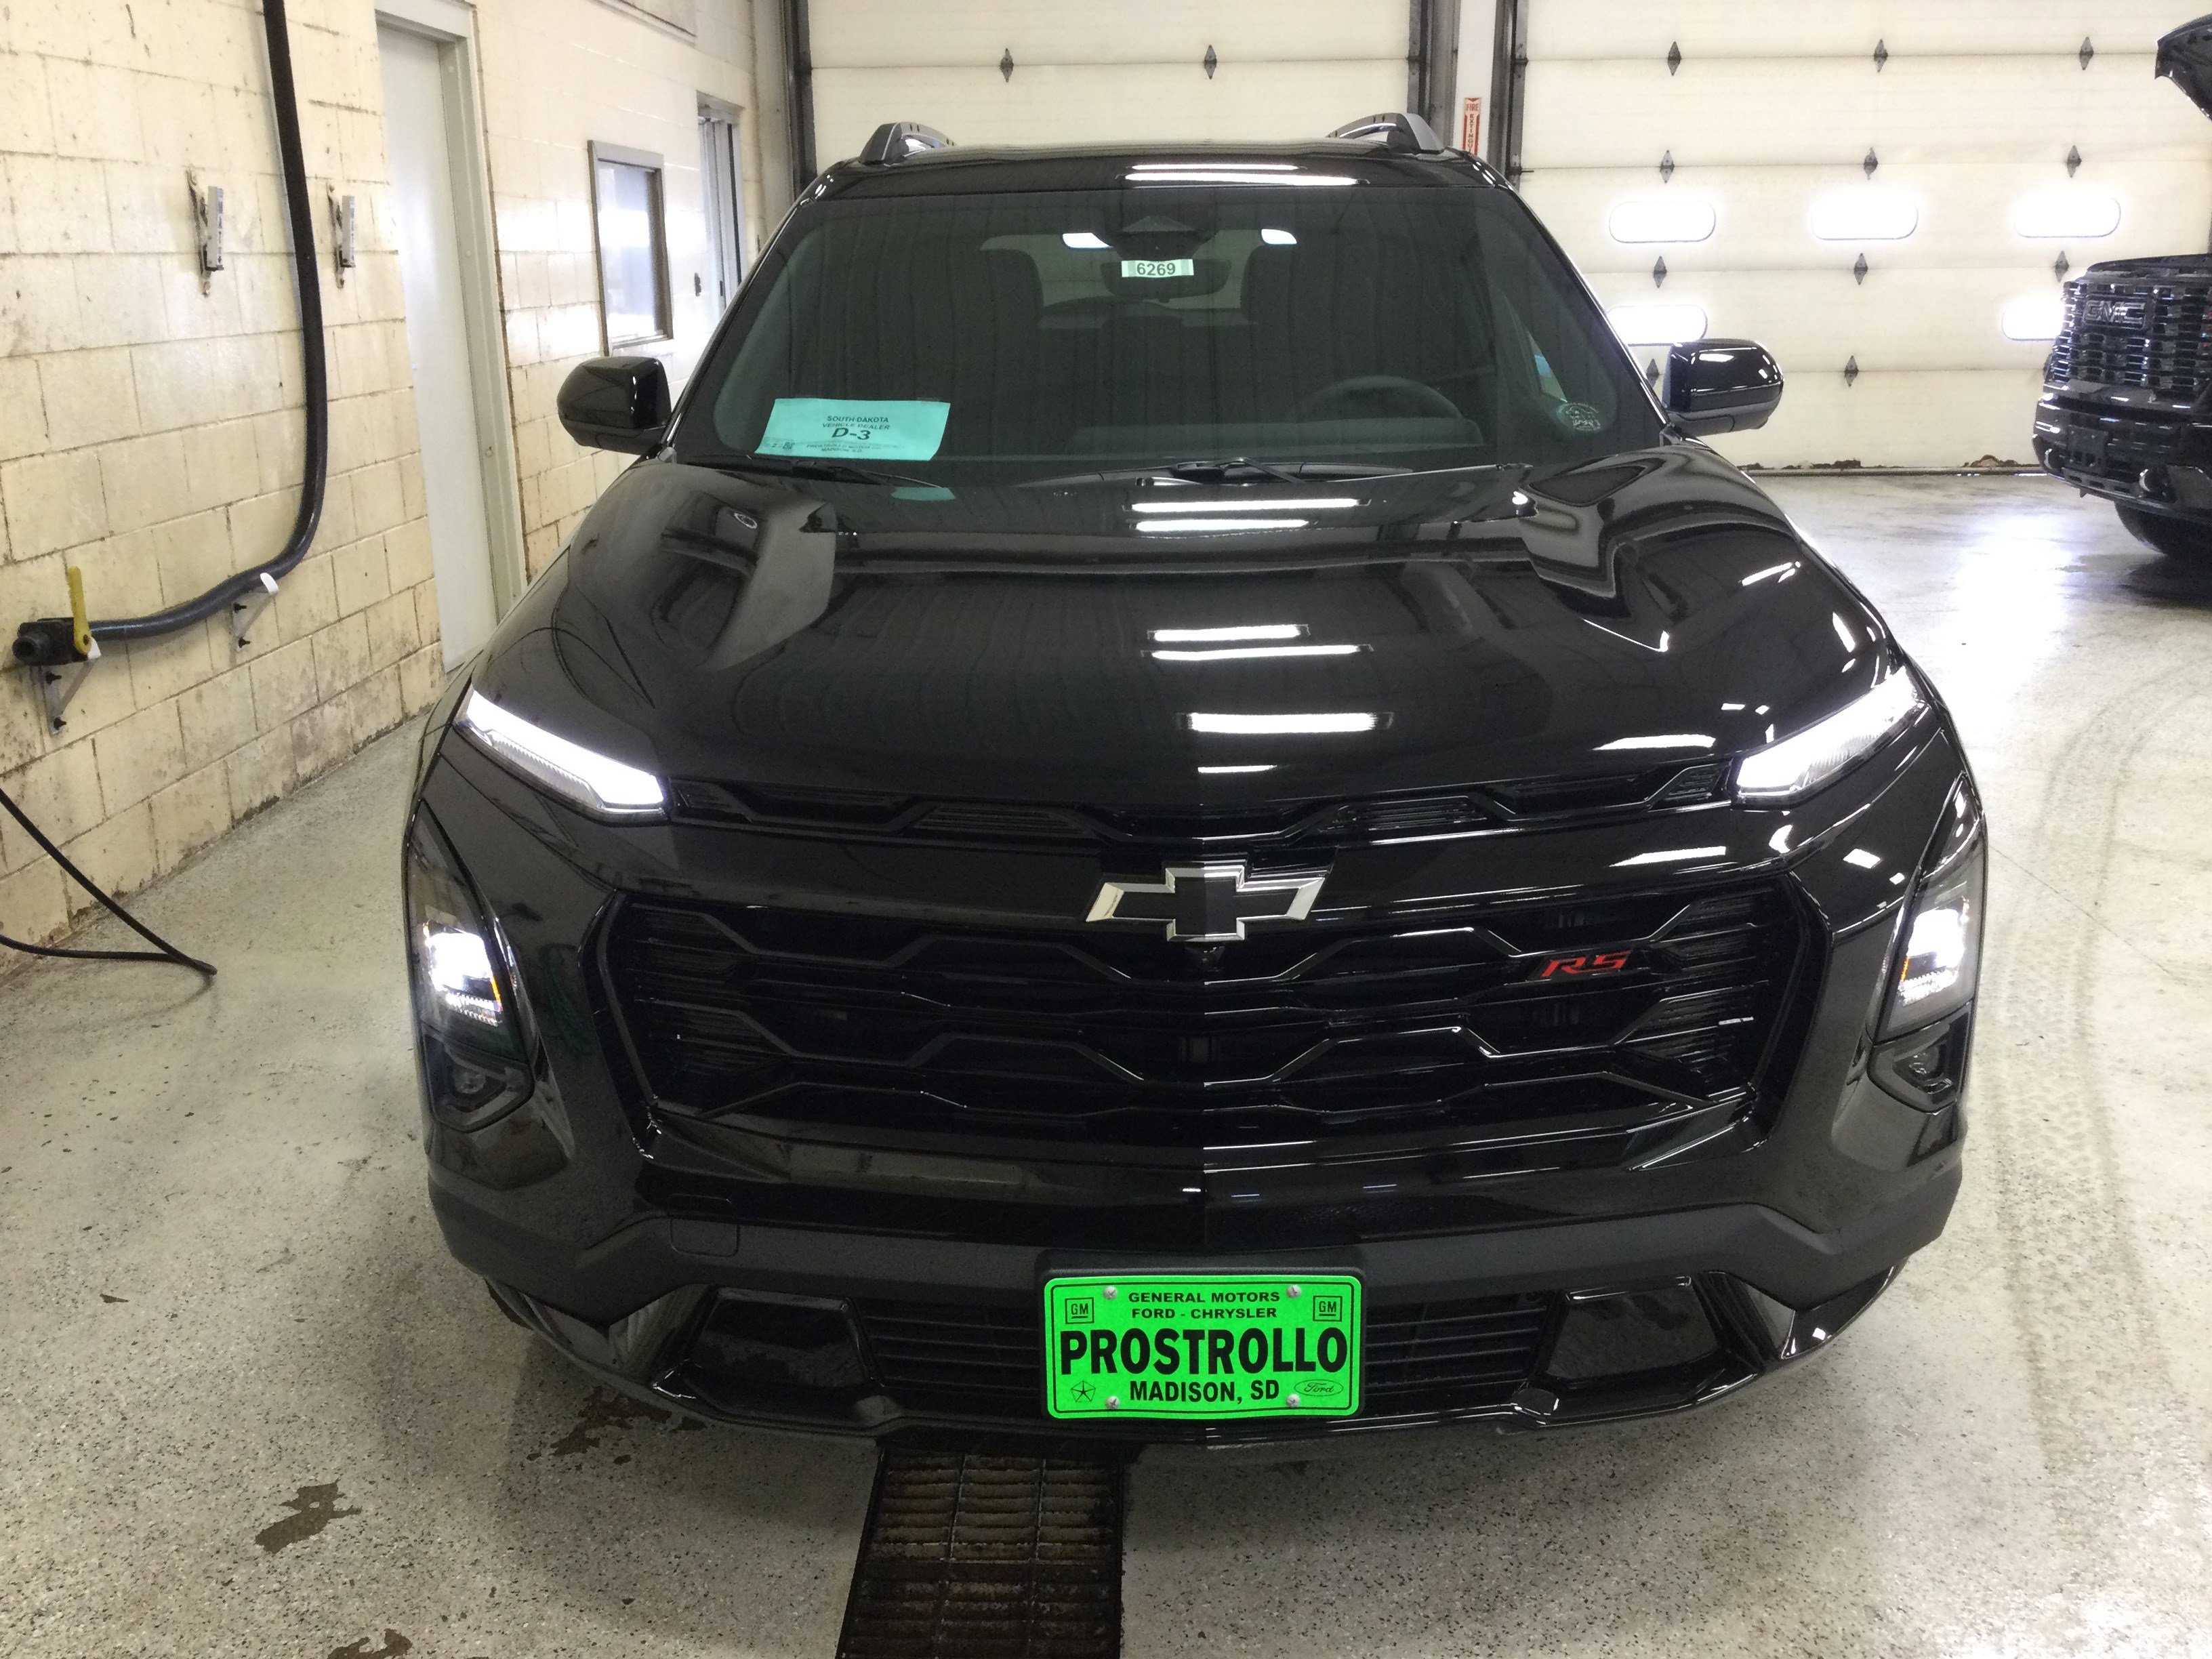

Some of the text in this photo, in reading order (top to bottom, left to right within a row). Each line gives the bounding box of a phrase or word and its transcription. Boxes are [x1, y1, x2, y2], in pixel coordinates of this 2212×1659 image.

[1136, 262, 1176, 276] 6269
[2085, 300, 2146, 324] GMC
[832, 427, 872, 441] D-3
[1540, 949, 1631, 978] RS
[1128, 1290, 1280, 1303] GENERAL MOTORS
[1070, 1303, 1090, 1316] GM
[1131, 1308, 1176, 1319] FORD
[1191, 1307, 1277, 1319] CHRYSLER
[1318, 1300, 1337, 1313] GM
[1060, 1327, 1348, 1375] PROSTROLLO
[1129, 1379, 1279, 1405] MADISON, SD
[1304, 1382, 1335, 1393] Ford
